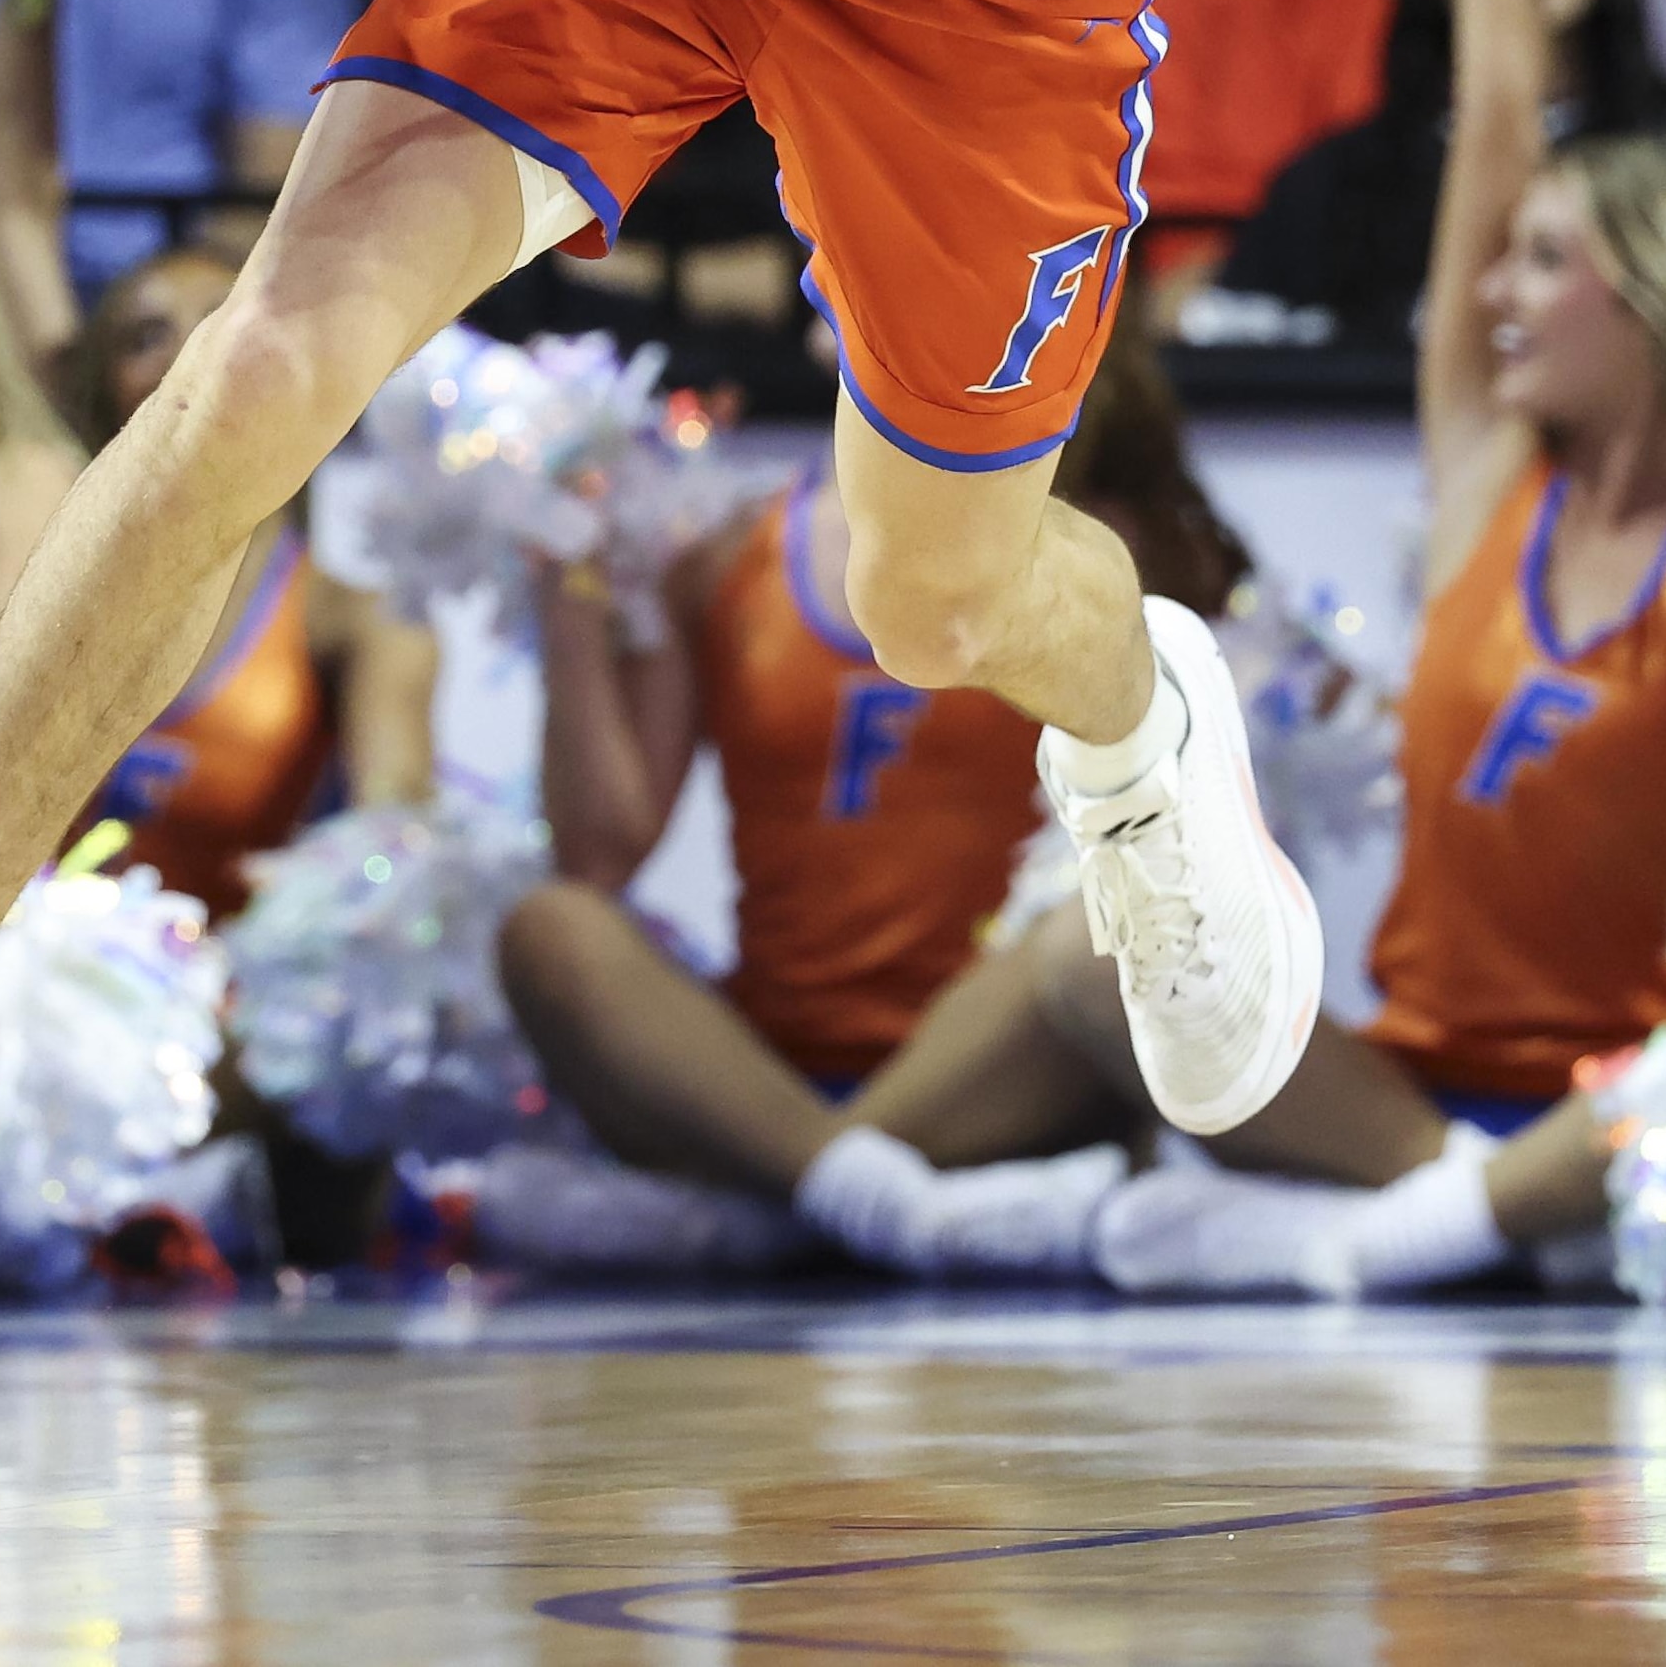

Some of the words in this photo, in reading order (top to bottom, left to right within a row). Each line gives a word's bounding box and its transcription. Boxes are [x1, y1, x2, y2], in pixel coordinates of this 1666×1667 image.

[964, 224, 1112, 394] F
[823, 675, 925, 822] F
[1459, 669, 1602, 807] F
